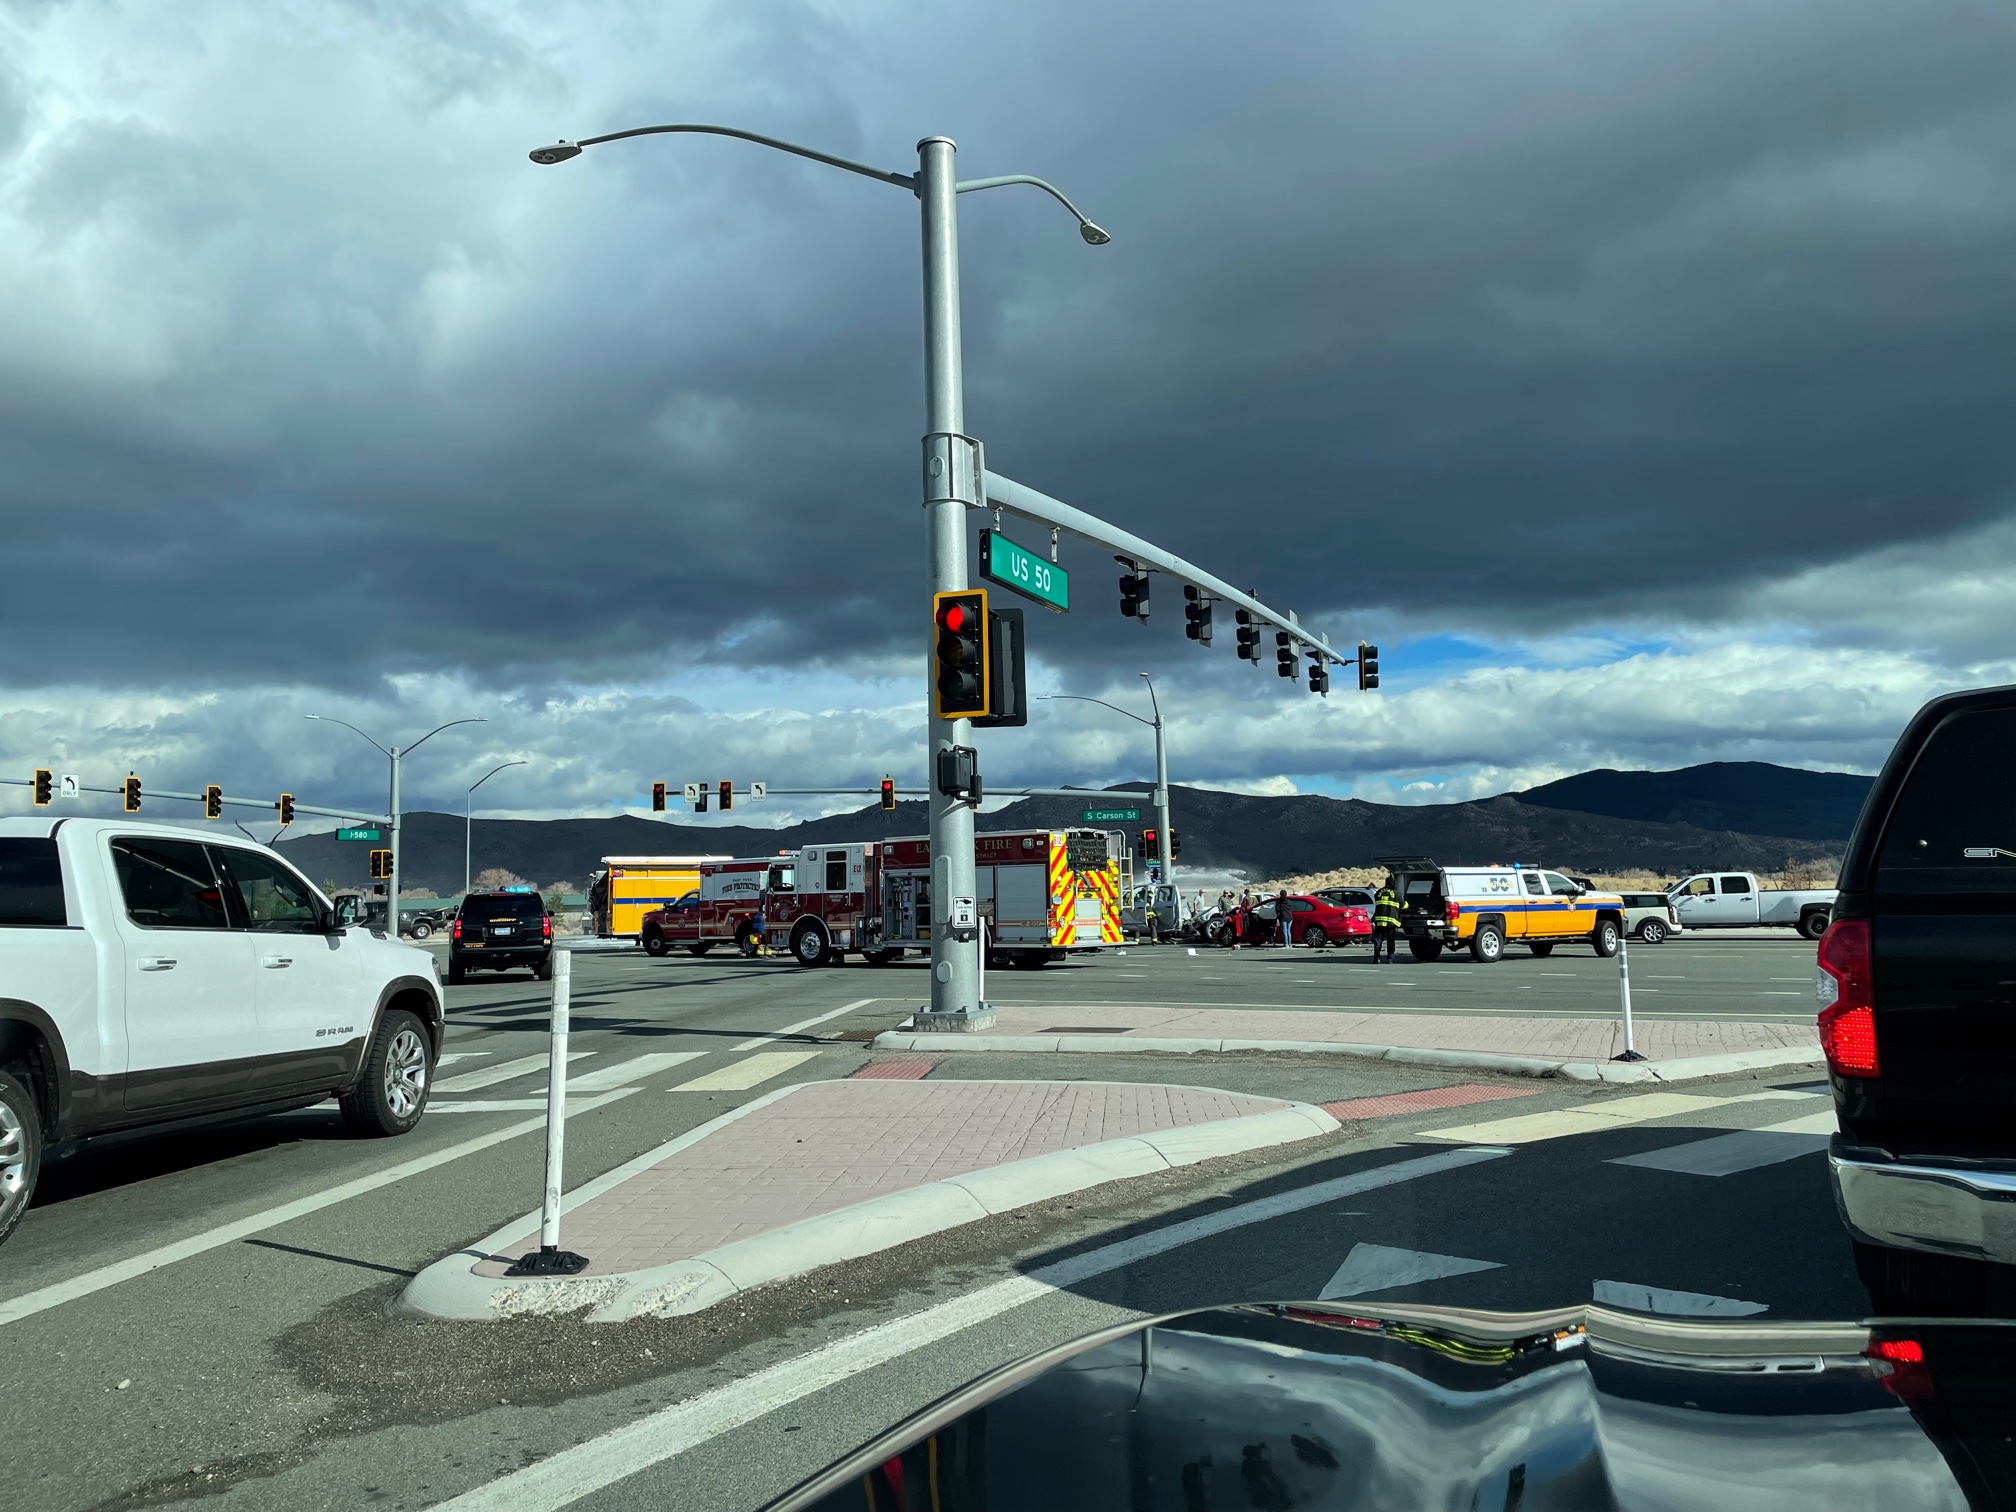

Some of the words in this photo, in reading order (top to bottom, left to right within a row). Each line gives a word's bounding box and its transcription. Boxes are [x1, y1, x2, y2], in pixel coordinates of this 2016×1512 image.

[1011, 552, 1029, 582] US
[1035, 564, 1051, 592] 50
[1087, 812, 1093, 820] S
[1096, 812, 1124, 820] Carson
[1127, 811, 1136, 819] St
[350, 831, 368, 839] I-580
[984, 839, 1013, 850] FIRE
[853, 864, 862, 873] E12
